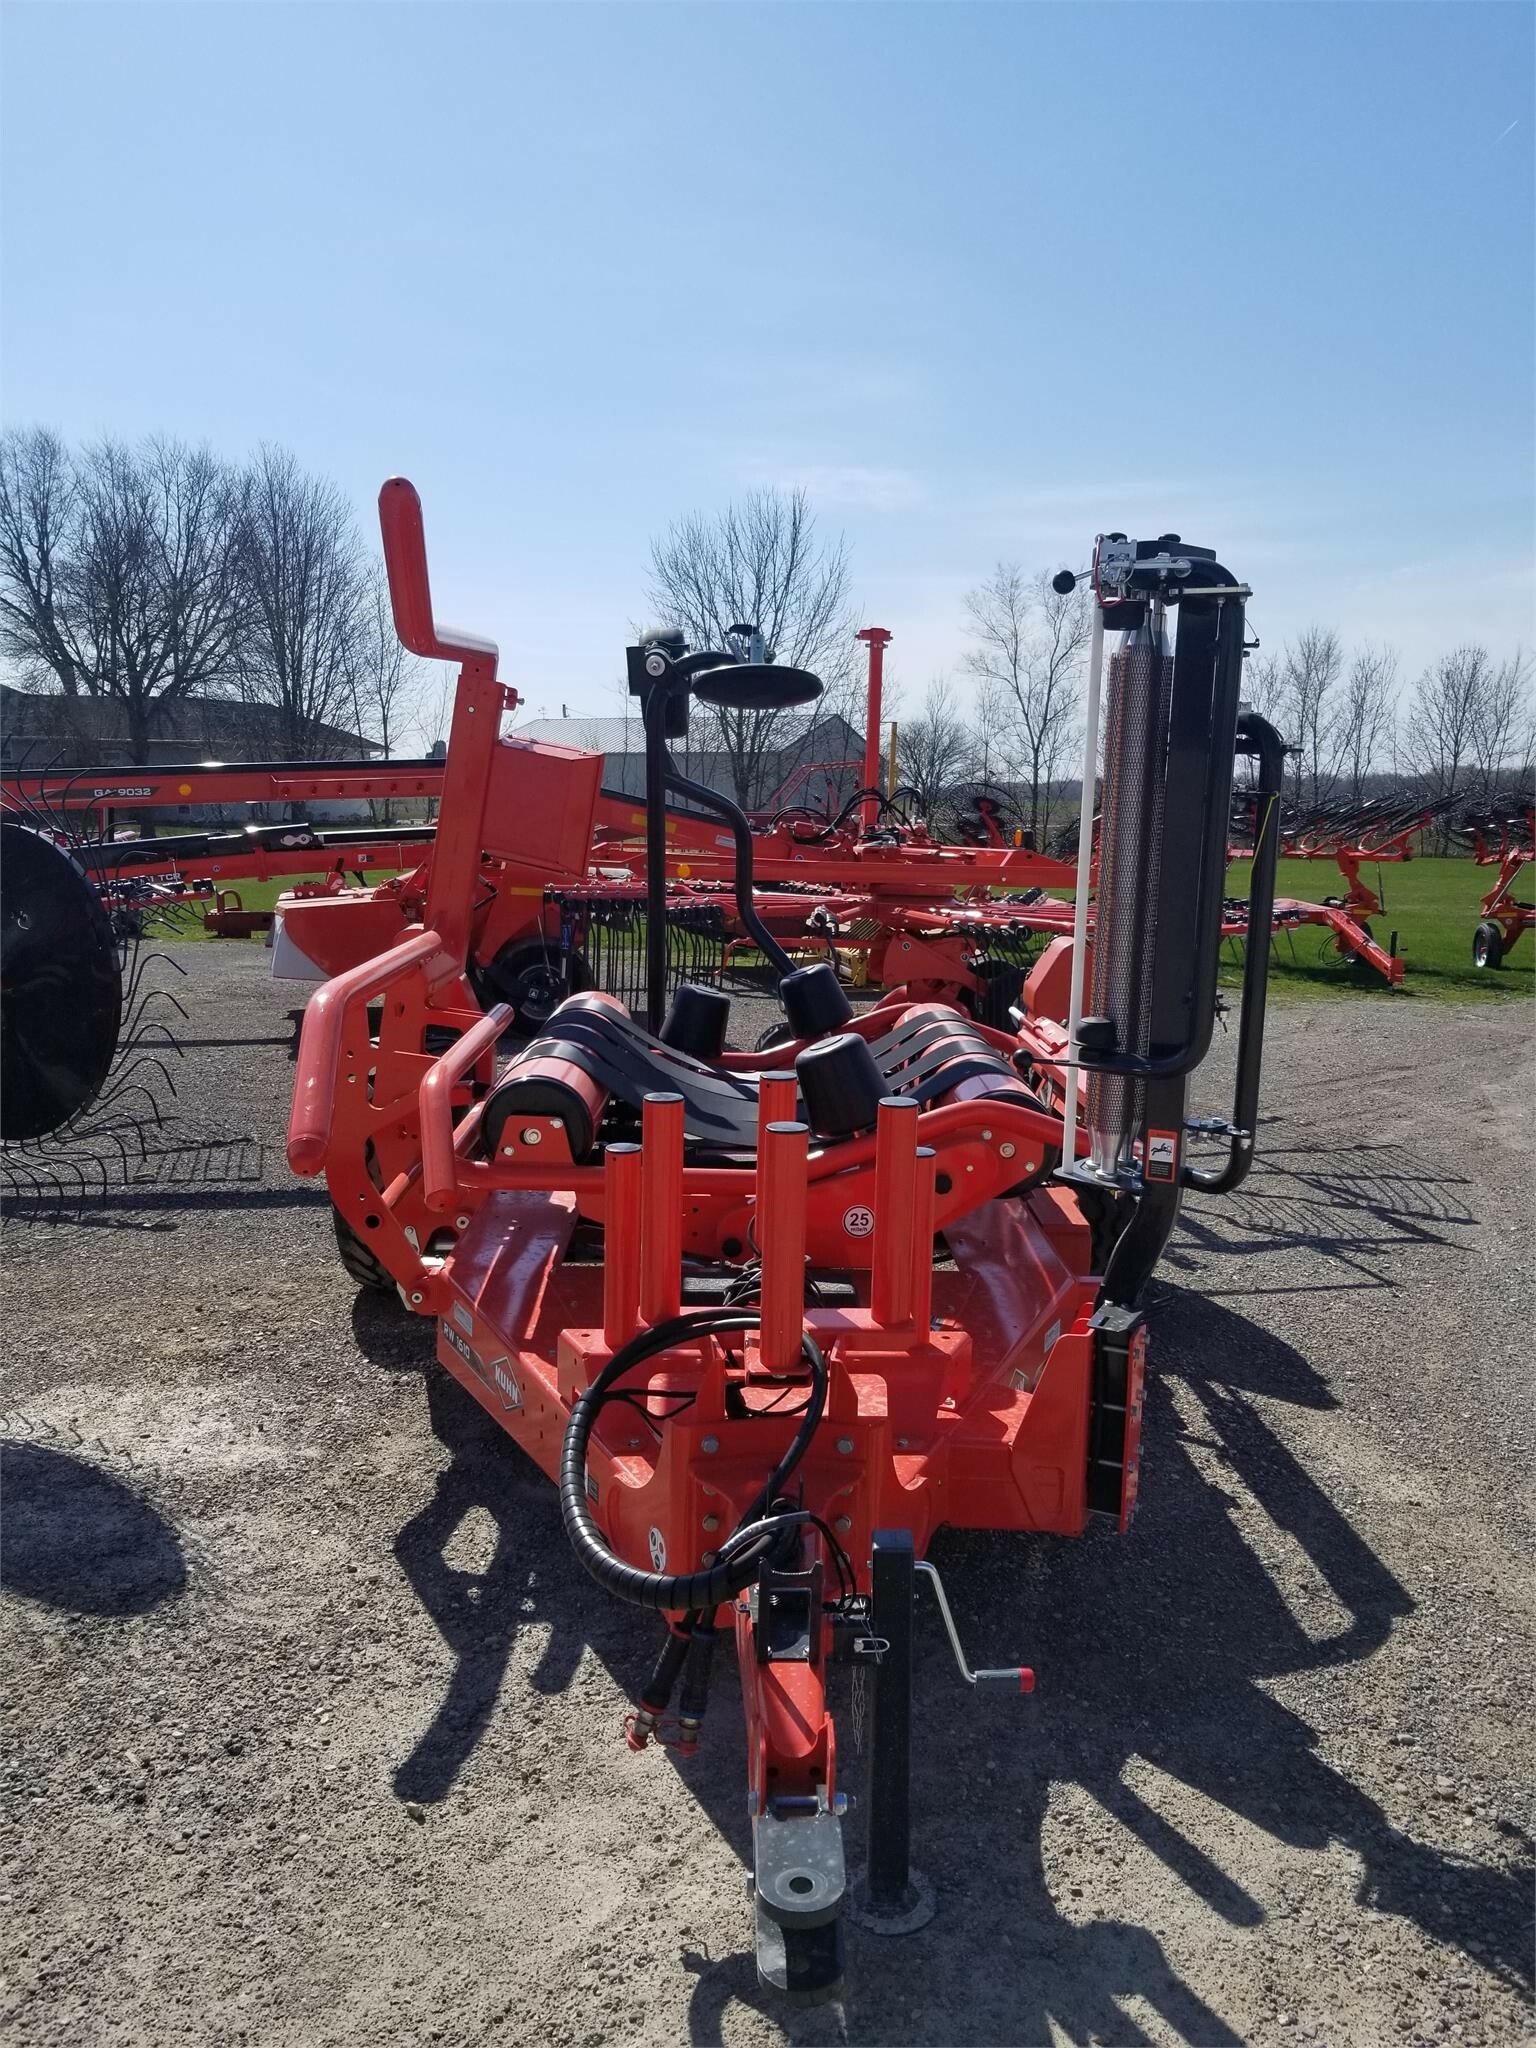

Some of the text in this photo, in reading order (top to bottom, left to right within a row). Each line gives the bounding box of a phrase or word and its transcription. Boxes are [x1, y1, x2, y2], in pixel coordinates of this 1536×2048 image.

[94, 788, 152, 797] GA 9032
[850, 1213, 869, 1226] 25
[443, 1322, 455, 1342] RW
[456, 1335, 471, 1360] 1610
[495, 1364, 518, 1404] KUHN
